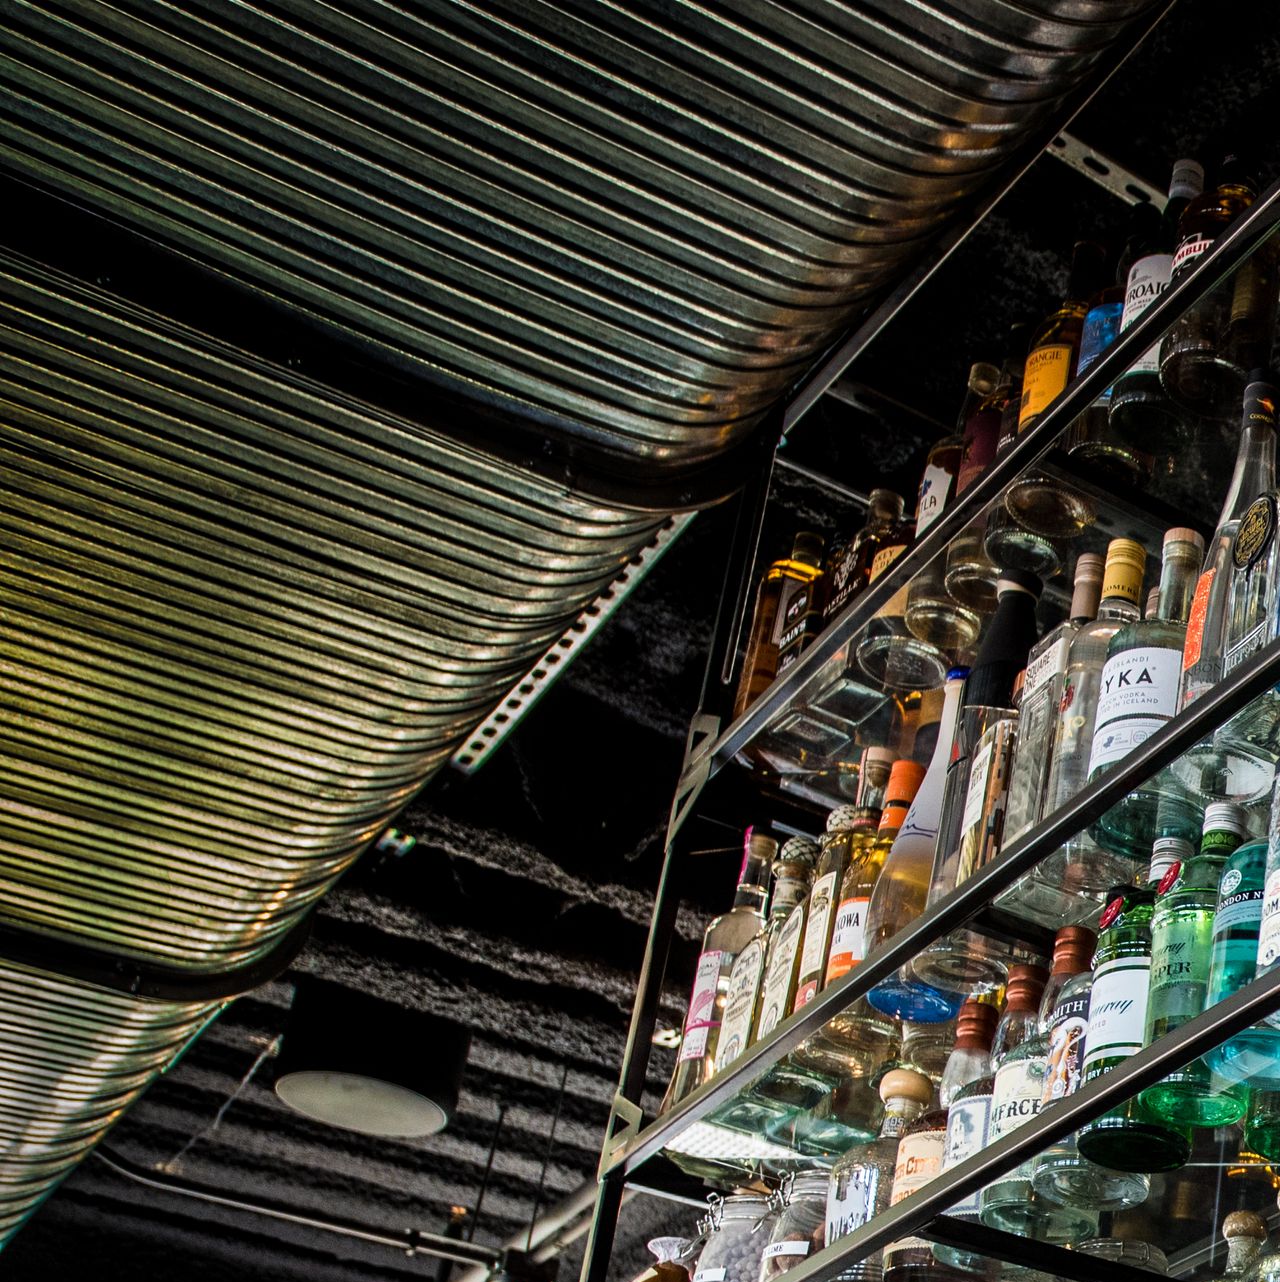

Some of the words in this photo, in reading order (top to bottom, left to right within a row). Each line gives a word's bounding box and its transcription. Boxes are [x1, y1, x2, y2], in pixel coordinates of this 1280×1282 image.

[1120, 691, 1146, 700] VODKA
[1123, 698, 1159, 706] ICELAND
[1088, 1068, 1102, 1080] DRY
